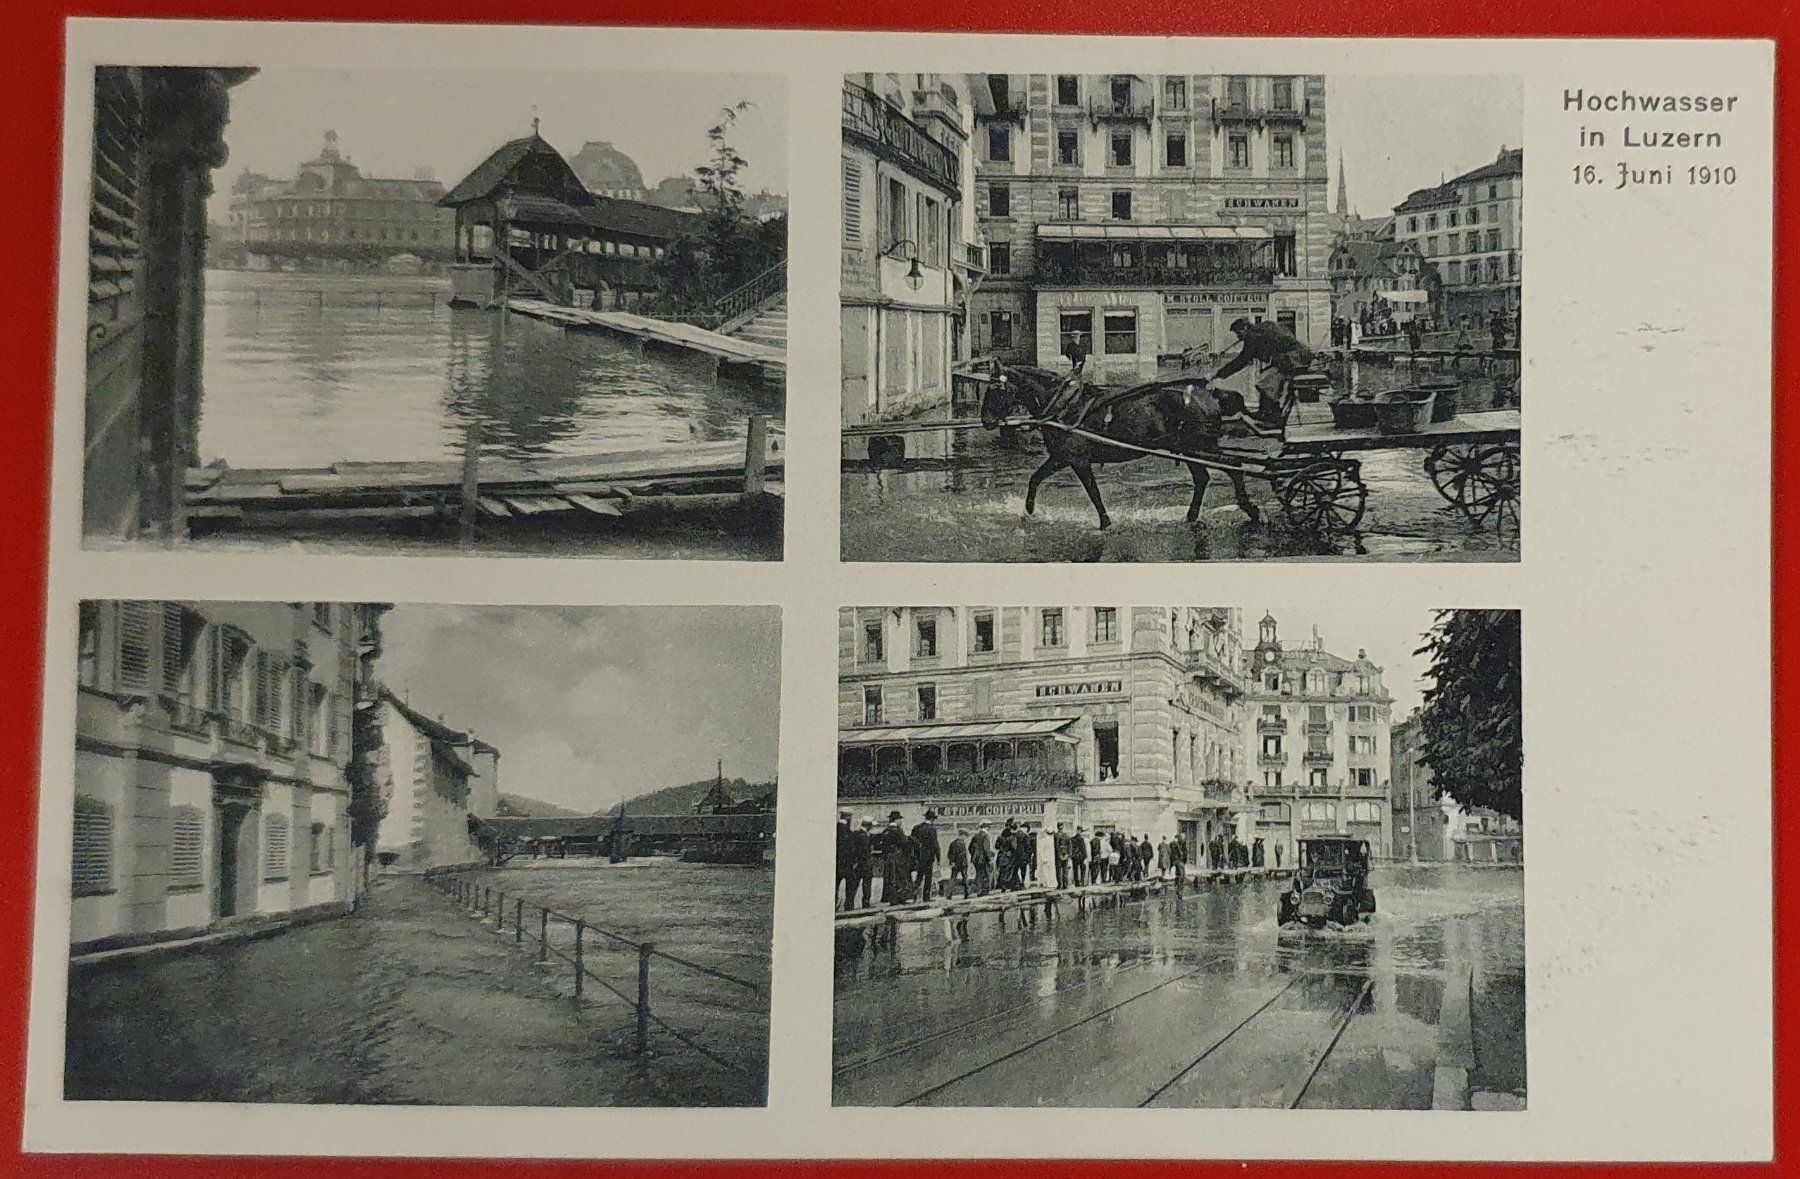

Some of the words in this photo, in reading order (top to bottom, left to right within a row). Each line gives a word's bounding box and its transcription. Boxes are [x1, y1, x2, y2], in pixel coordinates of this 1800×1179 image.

[1563, 89, 1738, 112] Hochwasser
[1580, 126, 1604, 147] in
[1624, 126, 1721, 147] Luzern
[1573, 165, 1603, 185] 16.
[1615, 162, 1672, 189] Juni
[1688, 165, 1736, 185] 1910
[1228, 198, 1297, 207] SCHWANEN
[1181, 293, 1212, 303] STOLL
[1039, 681, 1119, 696] SCHWANEN
